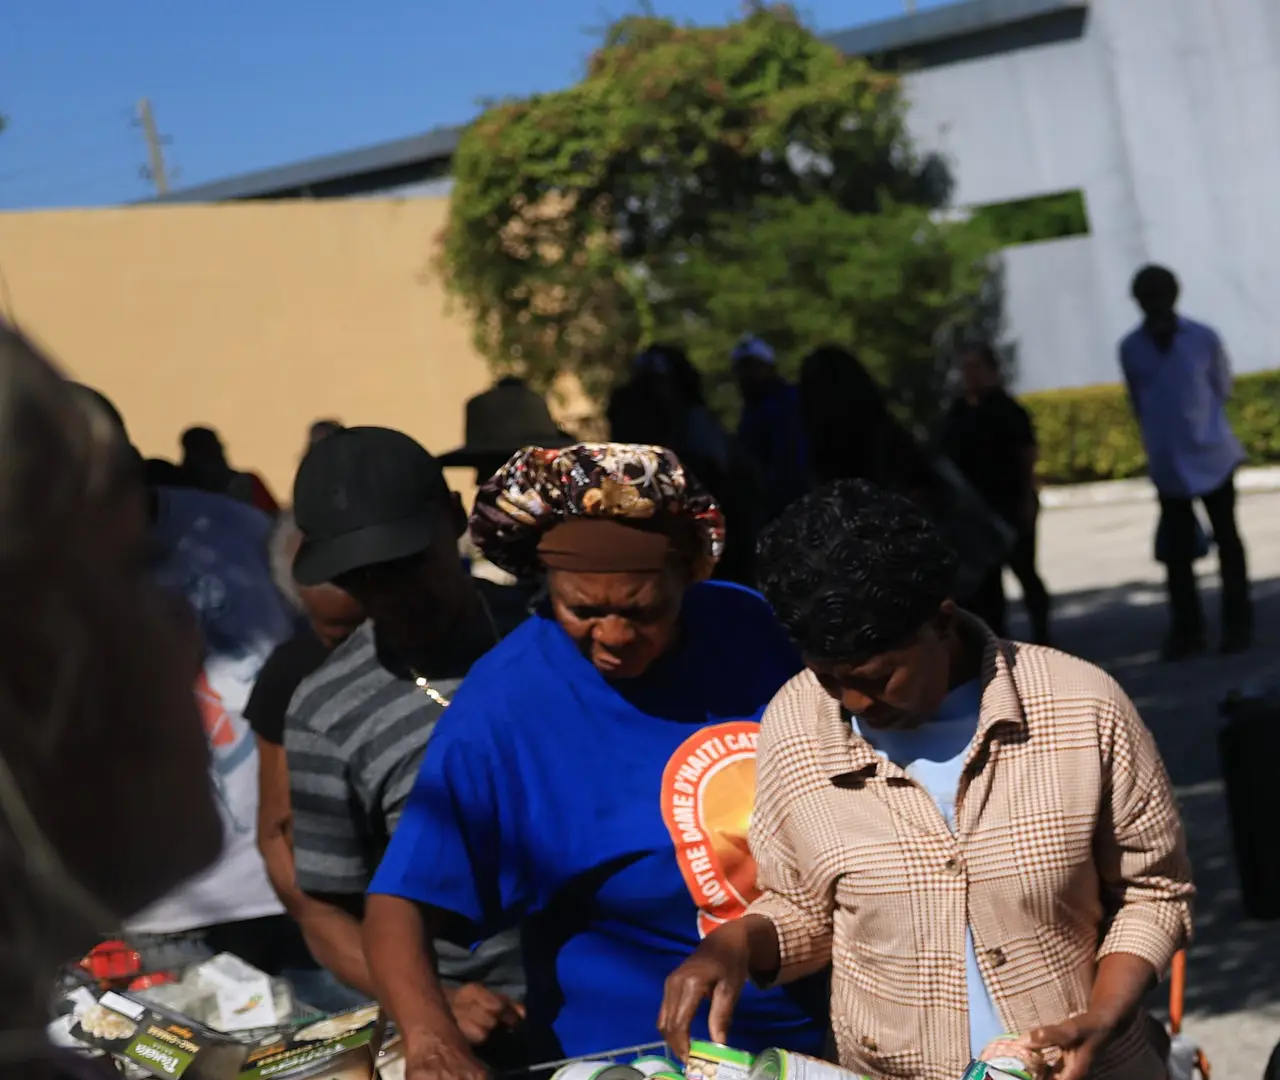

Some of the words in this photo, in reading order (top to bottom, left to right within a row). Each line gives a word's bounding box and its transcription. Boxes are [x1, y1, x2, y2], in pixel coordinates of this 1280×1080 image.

[674, 736, 725, 794] D'HAITI
[672, 795, 703, 844] DAME
[685, 844, 728, 907] NOTRE
